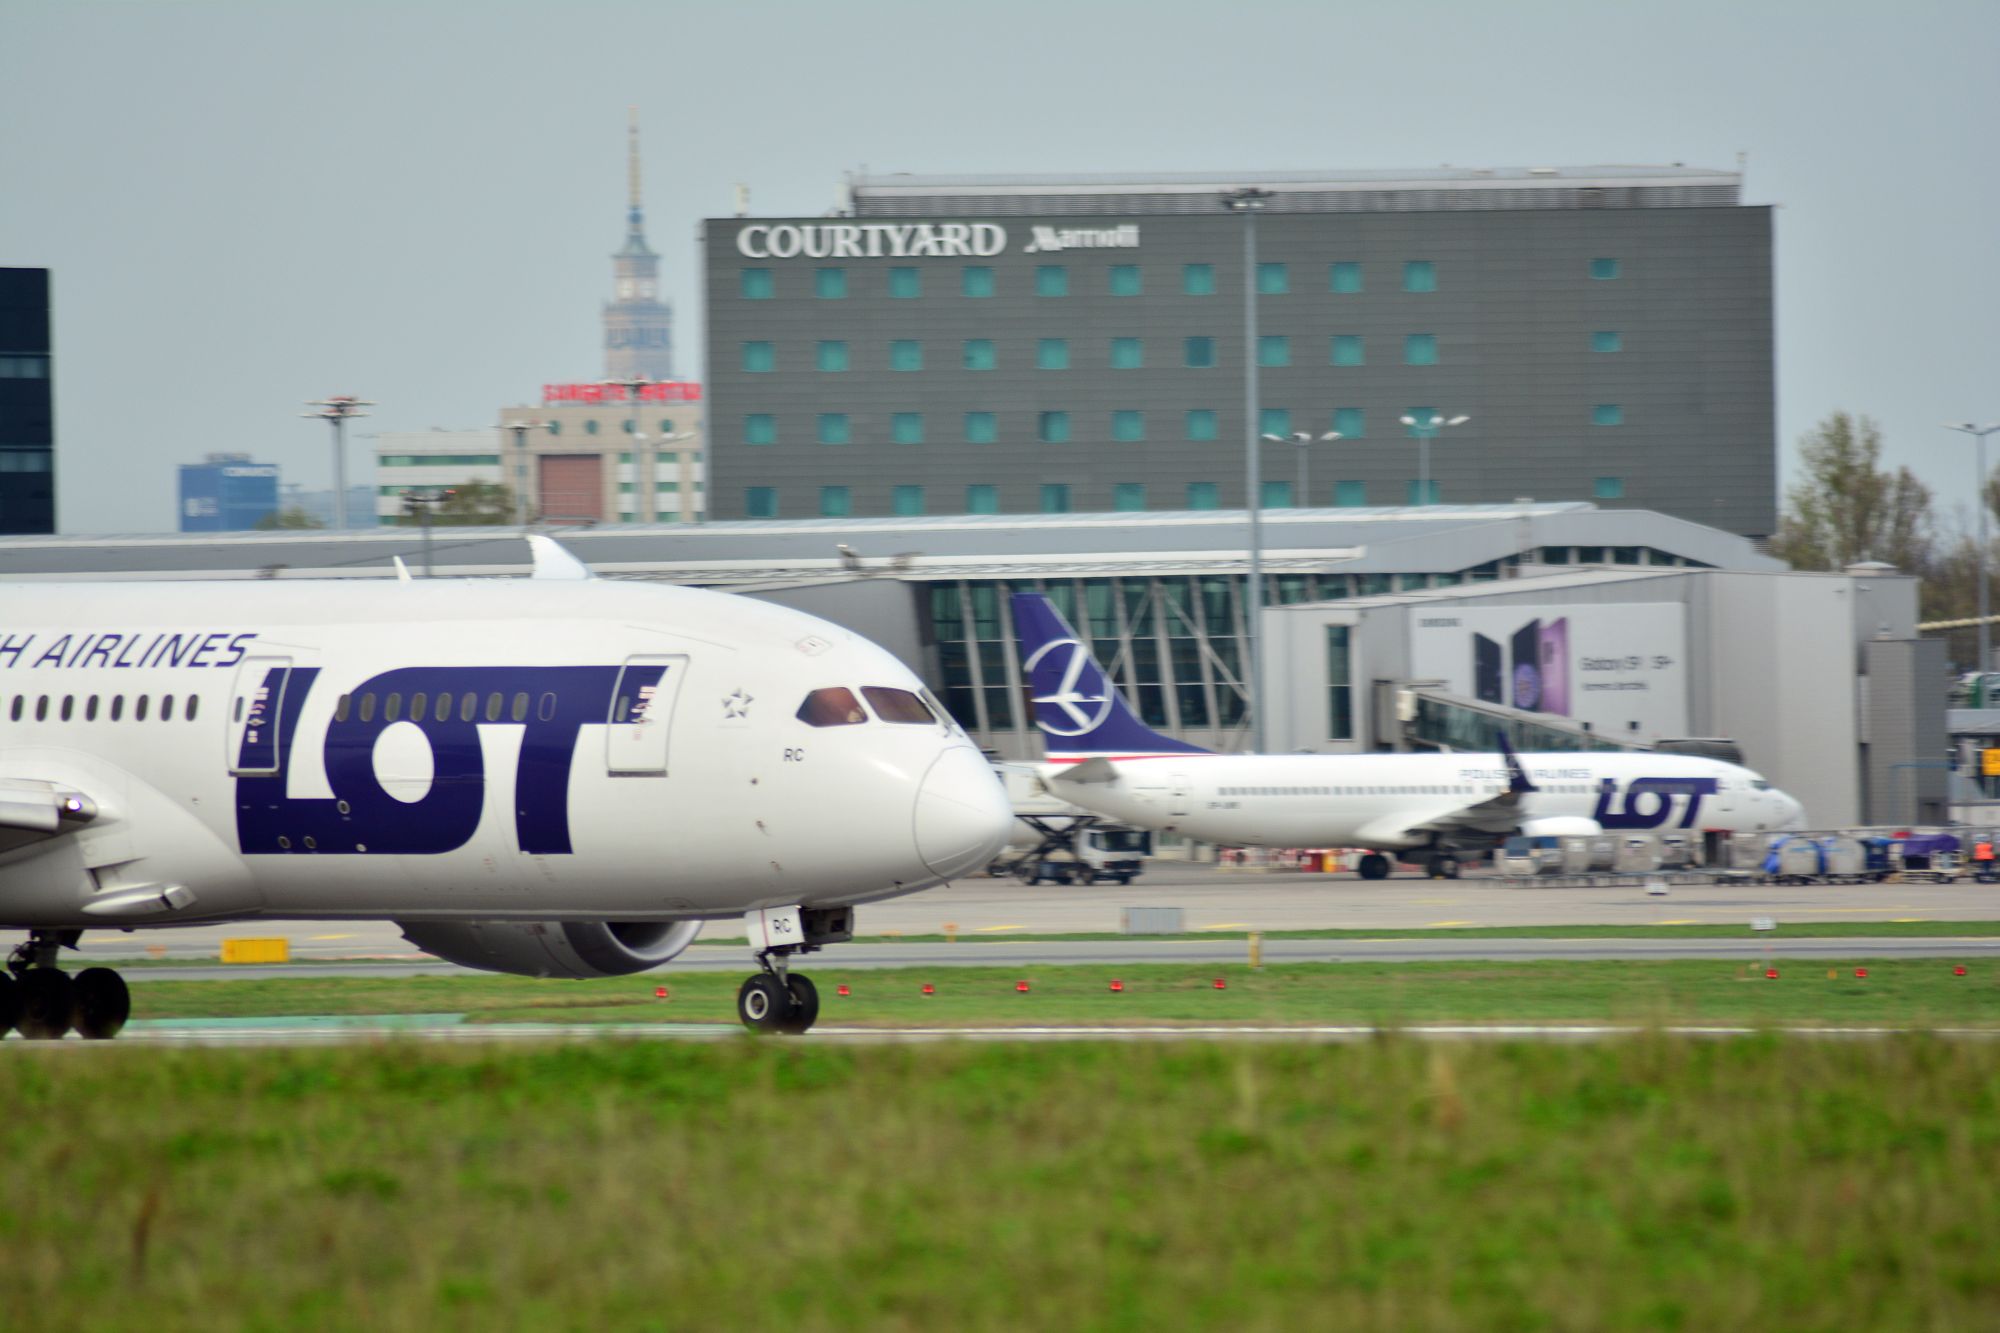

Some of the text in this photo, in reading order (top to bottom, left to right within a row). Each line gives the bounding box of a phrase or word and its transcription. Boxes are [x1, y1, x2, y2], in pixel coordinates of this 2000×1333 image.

[736, 223, 1139, 258] COURTYARD Marriott
[31, 633, 259, 668] AIRLINES
[236, 665, 669, 854] LOT
[783, 747, 804, 762] RC
[1593, 777, 1718, 829] LOT
[772, 918, 792, 934] RC
